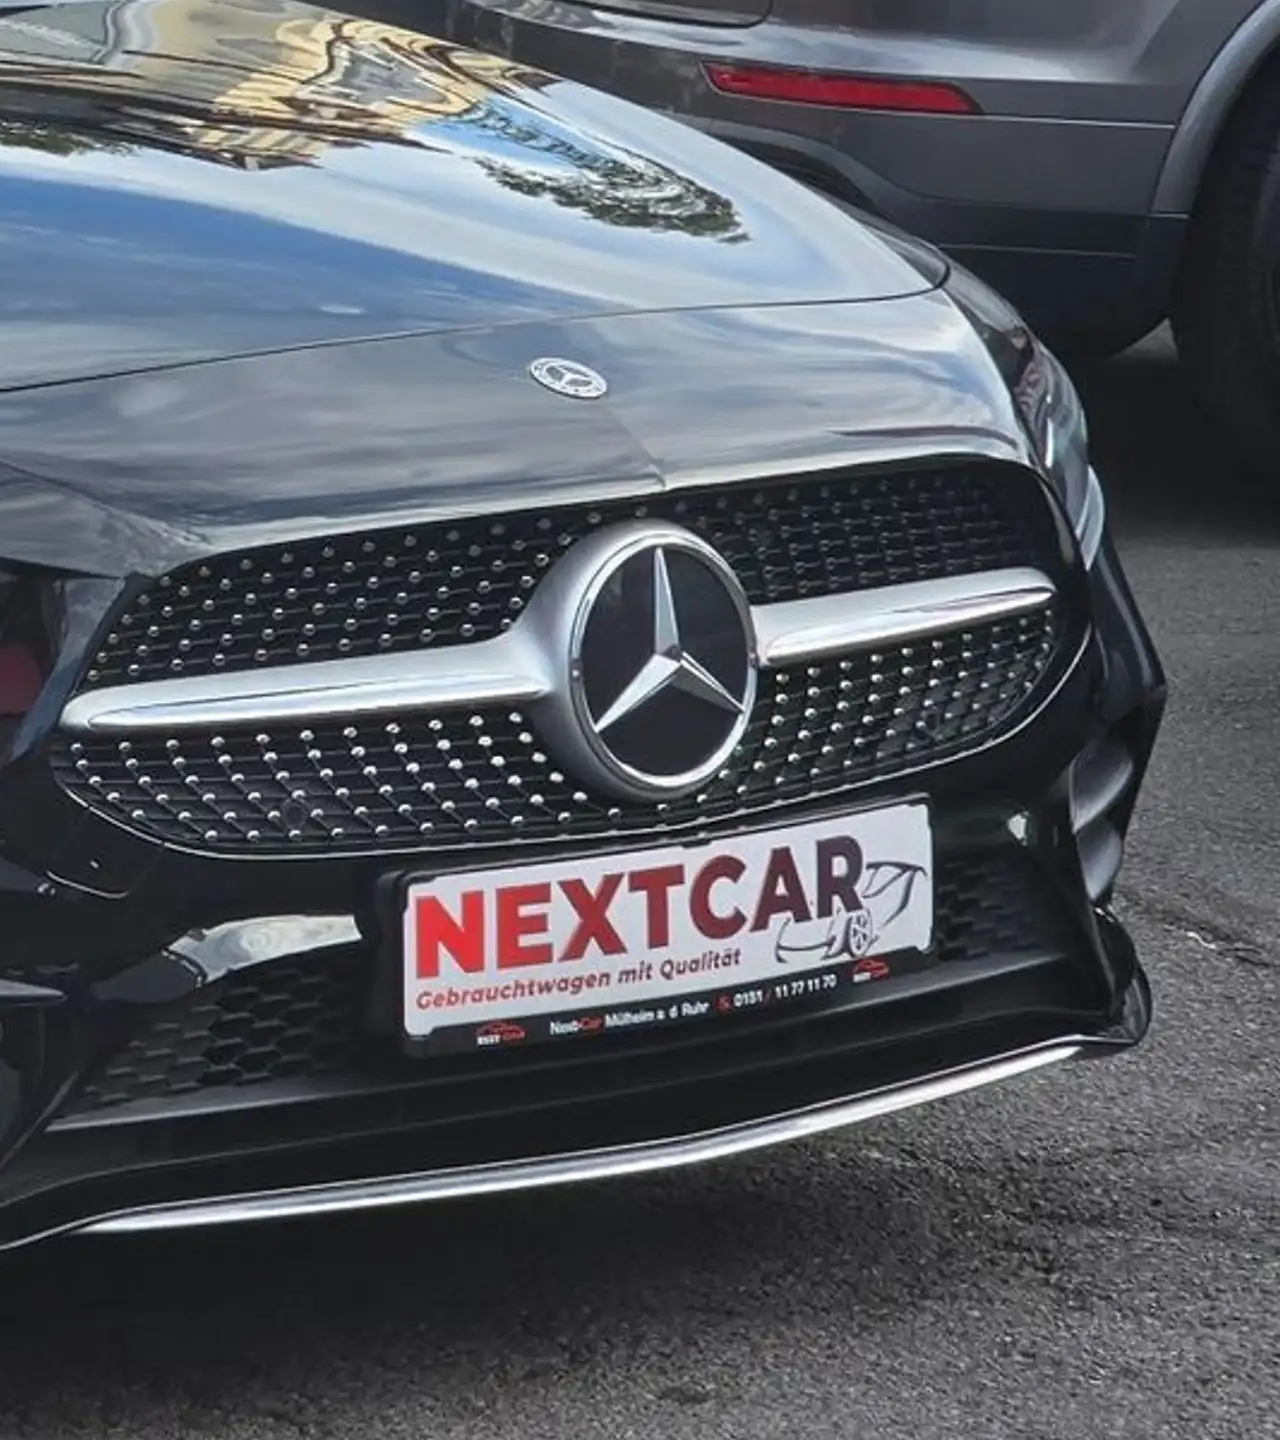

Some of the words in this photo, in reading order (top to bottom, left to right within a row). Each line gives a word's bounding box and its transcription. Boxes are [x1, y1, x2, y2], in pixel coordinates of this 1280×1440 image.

[416, 835, 864, 979] NEXTCAR
[415, 970, 611, 1010] Gebrauchtwagen
[617, 960, 653, 985] mit
[659, 948, 742, 980] Qualität
[681, 1000, 710, 1017] Ruhr
